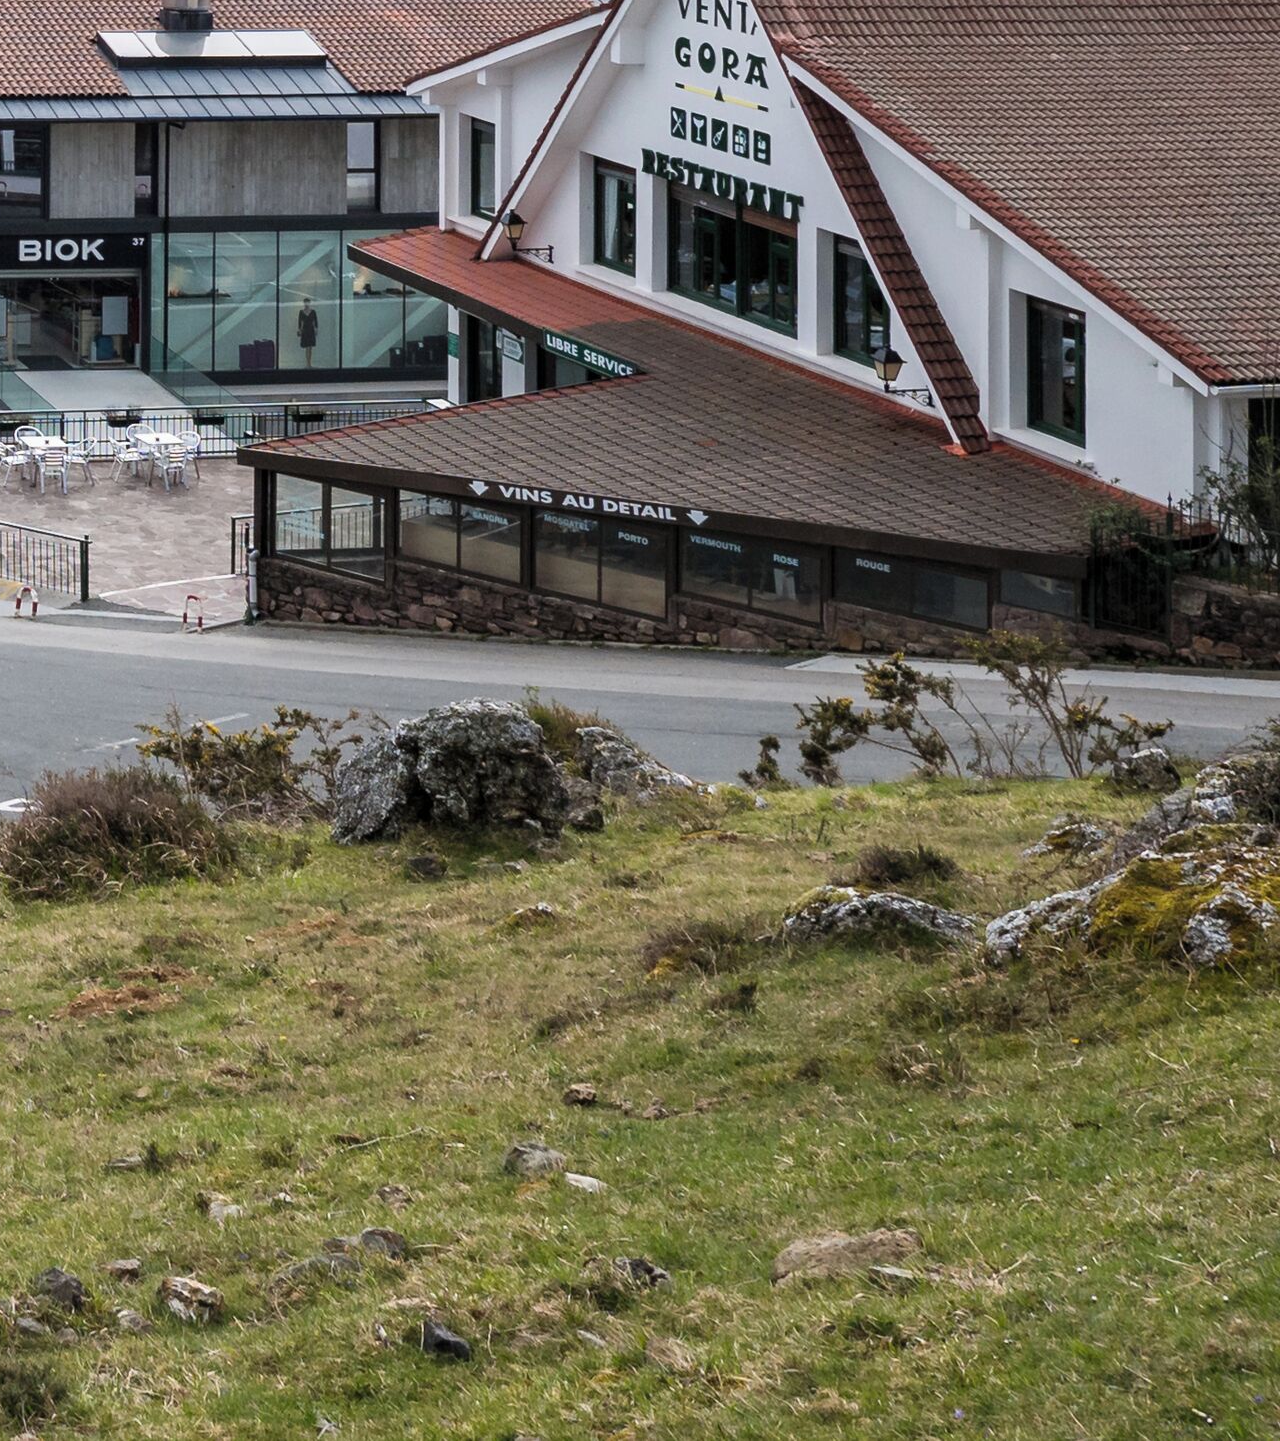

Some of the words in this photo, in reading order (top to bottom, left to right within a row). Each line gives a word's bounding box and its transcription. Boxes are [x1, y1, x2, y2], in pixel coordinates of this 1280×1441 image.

[674, 36, 769, 90] GORA
[641, 148, 805, 223] RESTAURANT
[18, 239, 105, 262] BIOK
[132, 238, 145, 246] 37
[546, 333, 579, 357] LIBRE
[583, 348, 634, 376] SERVICE
[498, 484, 553, 504] VINS
[561, 494, 594, 509] AU
[602, 499, 677, 521] DETAIL
[471, 509, 509, 526] SANGRIA
[618, 530, 649, 546] PORTO
[690, 534, 741, 553] VERMOUTH
[773, 553, 799, 567] ROSE
[856, 558, 891, 573] ROUGE
